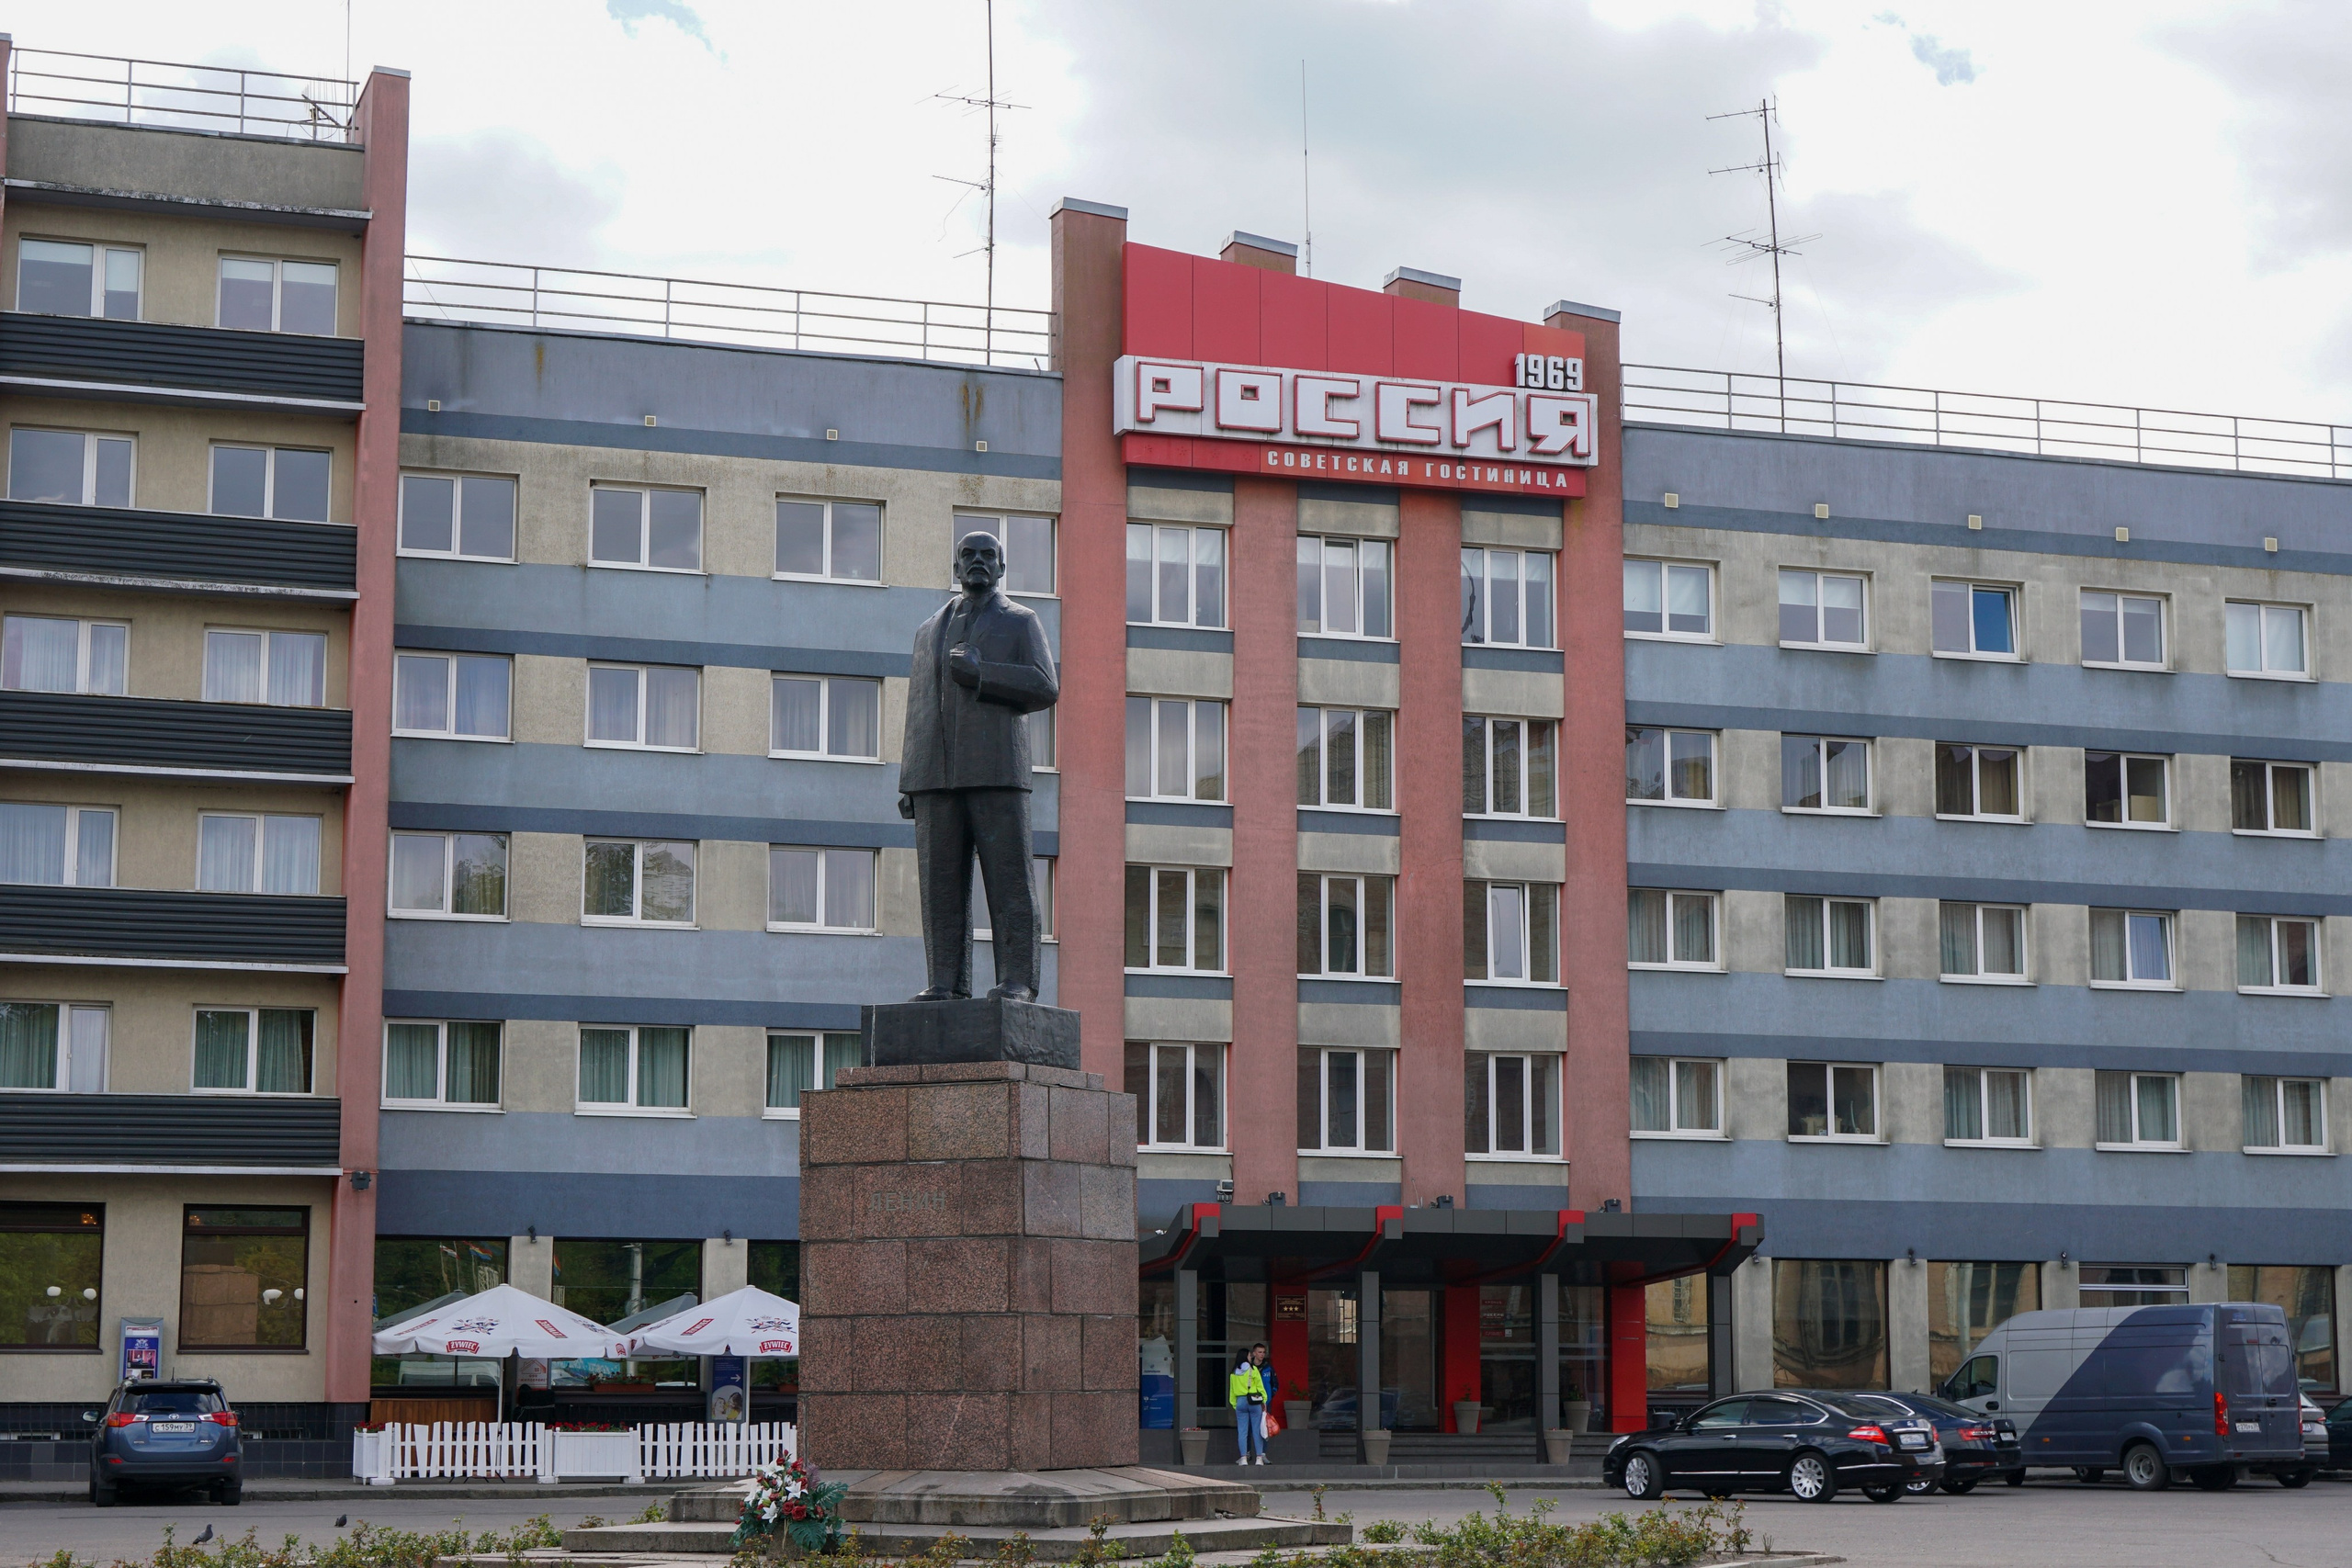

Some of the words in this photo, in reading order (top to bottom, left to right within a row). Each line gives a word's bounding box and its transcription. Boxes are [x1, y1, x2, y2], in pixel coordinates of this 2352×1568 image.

[1515, 353, 1584, 391] 1969
[1136, 361, 1591, 457] РОССИЯ
[1267, 450, 1409, 477] СОВЕТСКАЯ
[1425, 462, 1568, 490] ГОСТИНИЦА
[869, 1190, 946, 1212] ЛЕНИН
[450, 1339, 477, 1350] ŻYWIEC
[763, 1340, 789, 1350] ŻYWIEC
